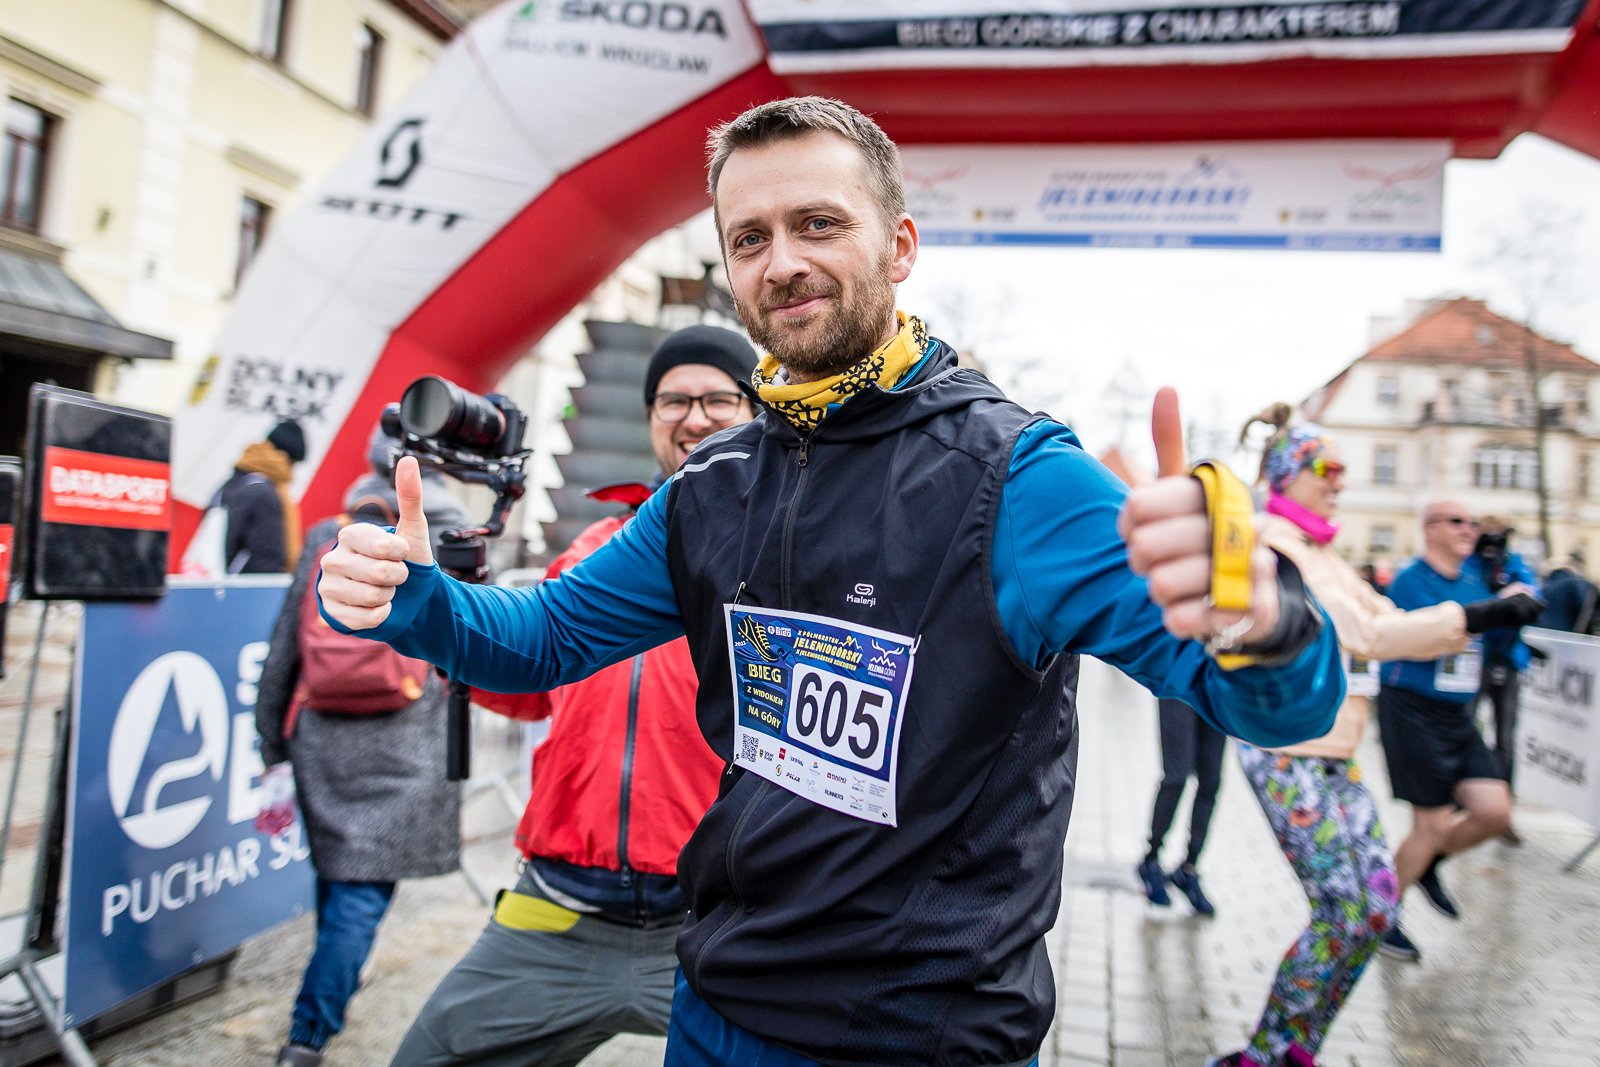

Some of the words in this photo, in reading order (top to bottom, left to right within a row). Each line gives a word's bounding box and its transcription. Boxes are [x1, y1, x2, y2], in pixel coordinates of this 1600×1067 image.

[321, 197, 472, 231] SCOTT
[51, 465, 169, 505] DATASPORT
[748, 663, 782, 684] BIEG
[746, 685, 752, 694] Z
[752, 687, 784, 707] WIDOKIEM
[748, 704, 759, 718] NA
[760, 711, 782, 729] GÓRY
[795, 671, 884, 760] 605
[102, 837, 261, 938] PUCHAR
